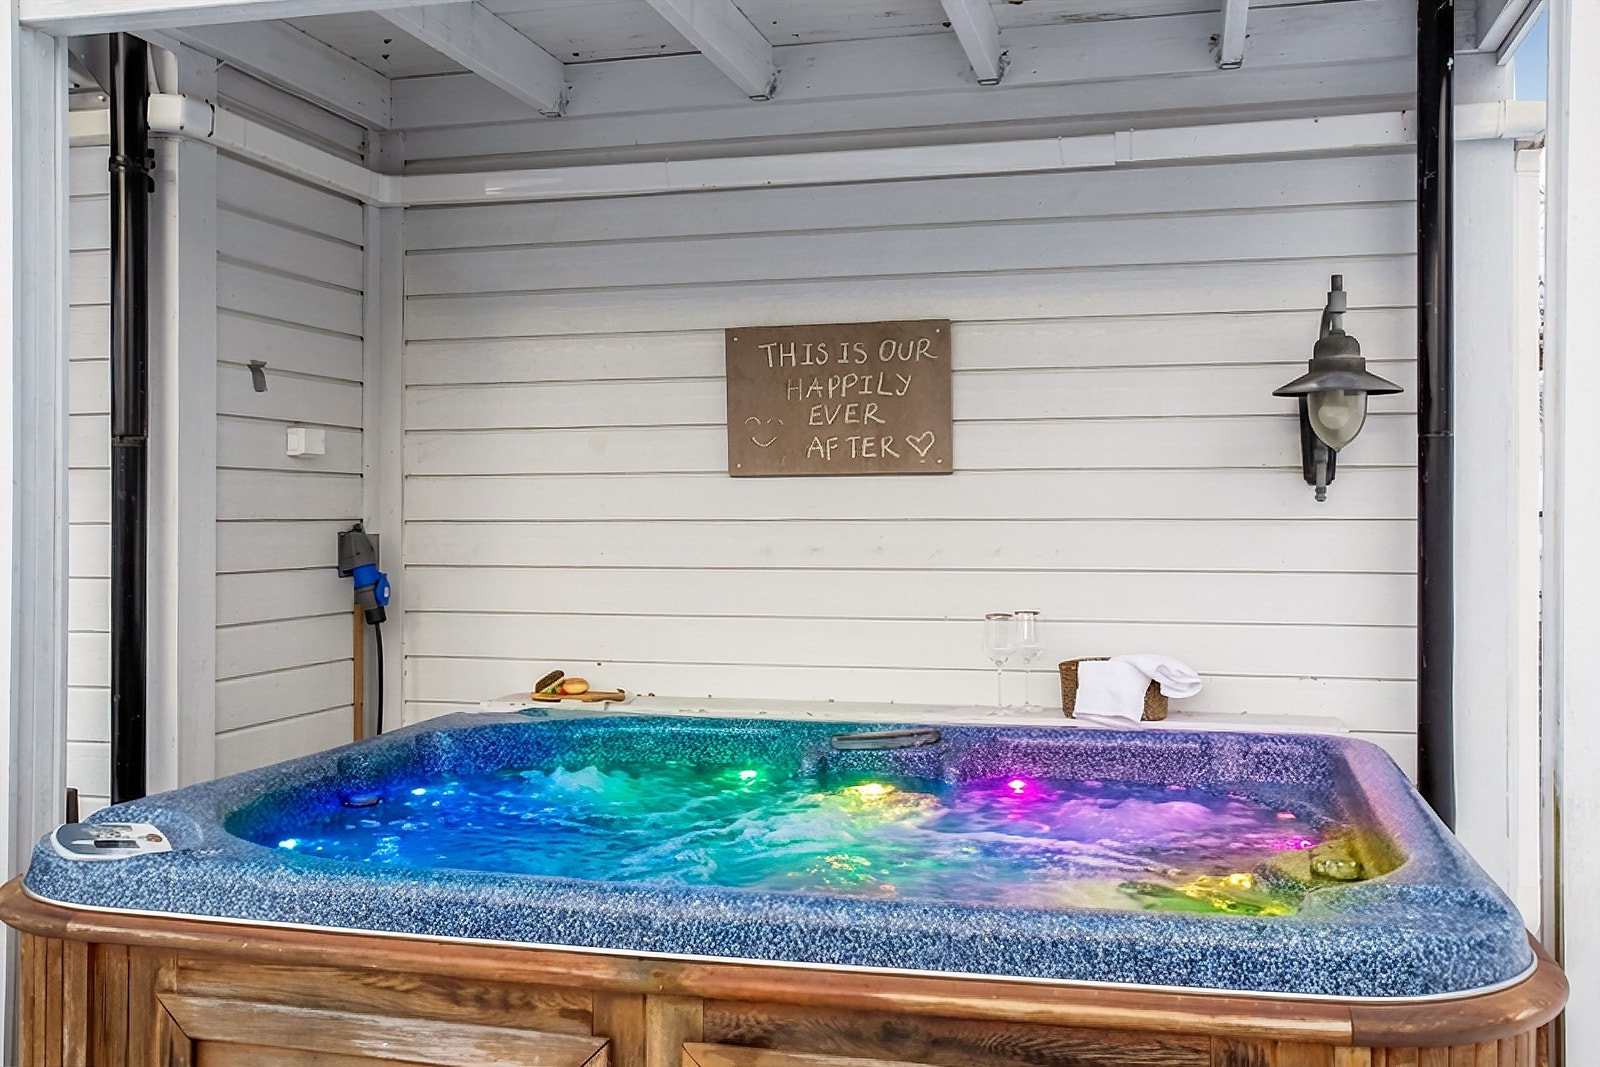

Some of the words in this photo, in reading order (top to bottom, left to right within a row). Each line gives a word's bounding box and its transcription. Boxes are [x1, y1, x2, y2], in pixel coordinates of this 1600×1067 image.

[758, 342, 829, 368] THIS
[837, 342, 868, 364] IS
[878, 338, 938, 362] OUR
[787, 371, 912, 401] HAPPILY
[808, 402, 886, 426] EVER
[807, 435, 900, 461] AFTER
